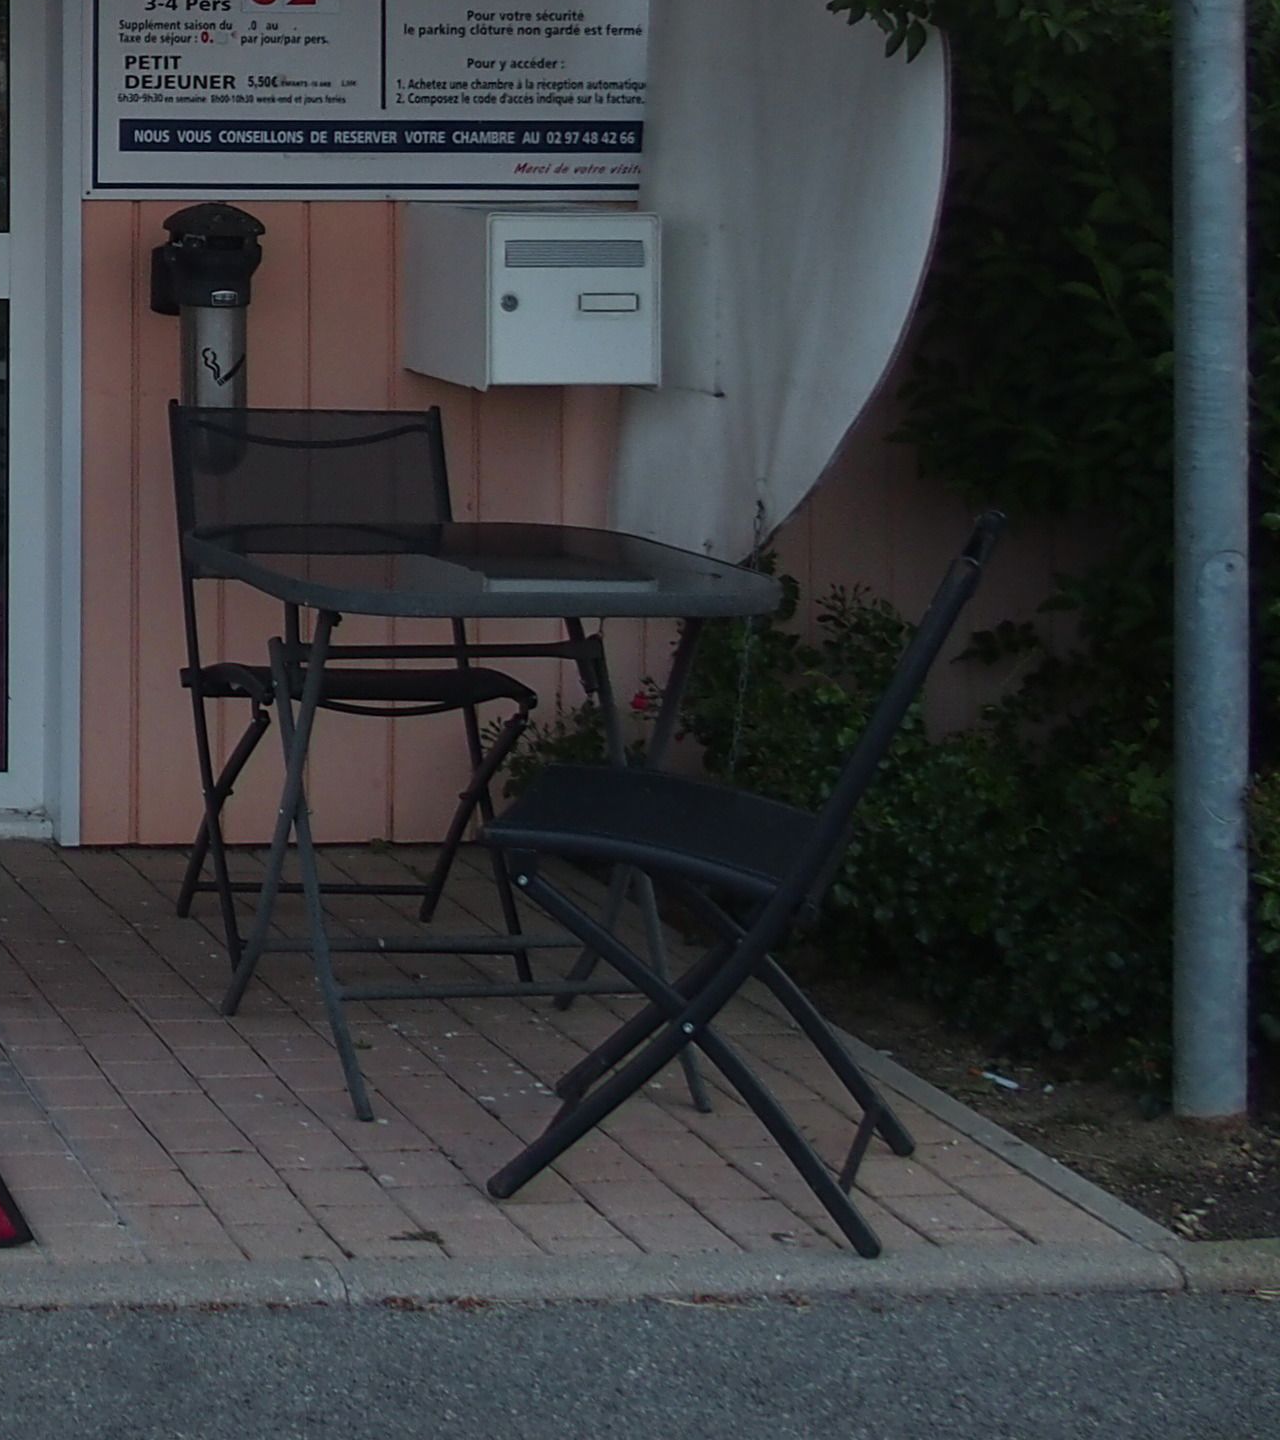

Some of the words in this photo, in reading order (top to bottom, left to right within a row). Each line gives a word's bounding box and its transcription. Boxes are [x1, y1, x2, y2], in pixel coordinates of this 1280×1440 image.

[467, 10, 496, 21] Pour
[500, 11, 532, 21] votre
[536, 9, 585, 21] sécurité
[119, 20, 181, 32] Supplément
[184, 21, 216, 31] saison
[219, 20, 233, 31] du
[266, 22, 279, 31] au
[403, 23, 415, 35] le
[418, 23, 466, 38] parking
[517, 25, 541, 35] non
[544, 23, 580, 38] gardé
[584, 25, 602, 35] est
[606, 23, 642, 36] fermé
[119, 33, 142, 43] Taxe
[145, 32, 158, 43] de
[160, 32, 191, 46] séjour
[240, 36, 258, 46] par
[260, 34, 301, 47] jour/par
[124, 55, 182, 70] PETIT
[467, 59, 496, 69] Pour
[500, 61, 507, 71] y
[510, 57, 558, 69] accéder
[124, 75, 236, 89] DEJEUNER
[247, 75, 278, 89] 5,50€
[408, 79, 447, 90] Achetez
[449, 81, 468, 90] une
[471, 79, 514, 90] chambre
[525, 79, 535, 90] la
[536, 79, 584, 92] réception
[586, 79, 646, 93] automatiqu
[408, 93, 458, 106] Composez
[461, 93, 471, 103] le
[473, 93, 497, 104] code
[577, 96, 592, 104] sur
[595, 93, 604, 104] la
[134, 130, 170, 143] NOUS
[177, 130, 211, 143] VOUS
[218, 130, 304, 143] CONSEILLONS
[310, 130, 328, 143] DE
[334, 131, 397, 144] RESERVER
[404, 131, 445, 144] VOTRE
[452, 131, 515, 144] CHAMBRE
[522, 132, 540, 144] AU
[546, 132, 562, 144] 02
[565, 132, 579, 144] 97
[582, 132, 598, 144] 48
[601, 132, 617, 144] 42
[620, 132, 635, 144] 66
[514, 162, 551, 175] Merci
[554, 163, 569, 174] de
[573, 164, 605, 174] votre
[610, 163, 641, 174] visit
